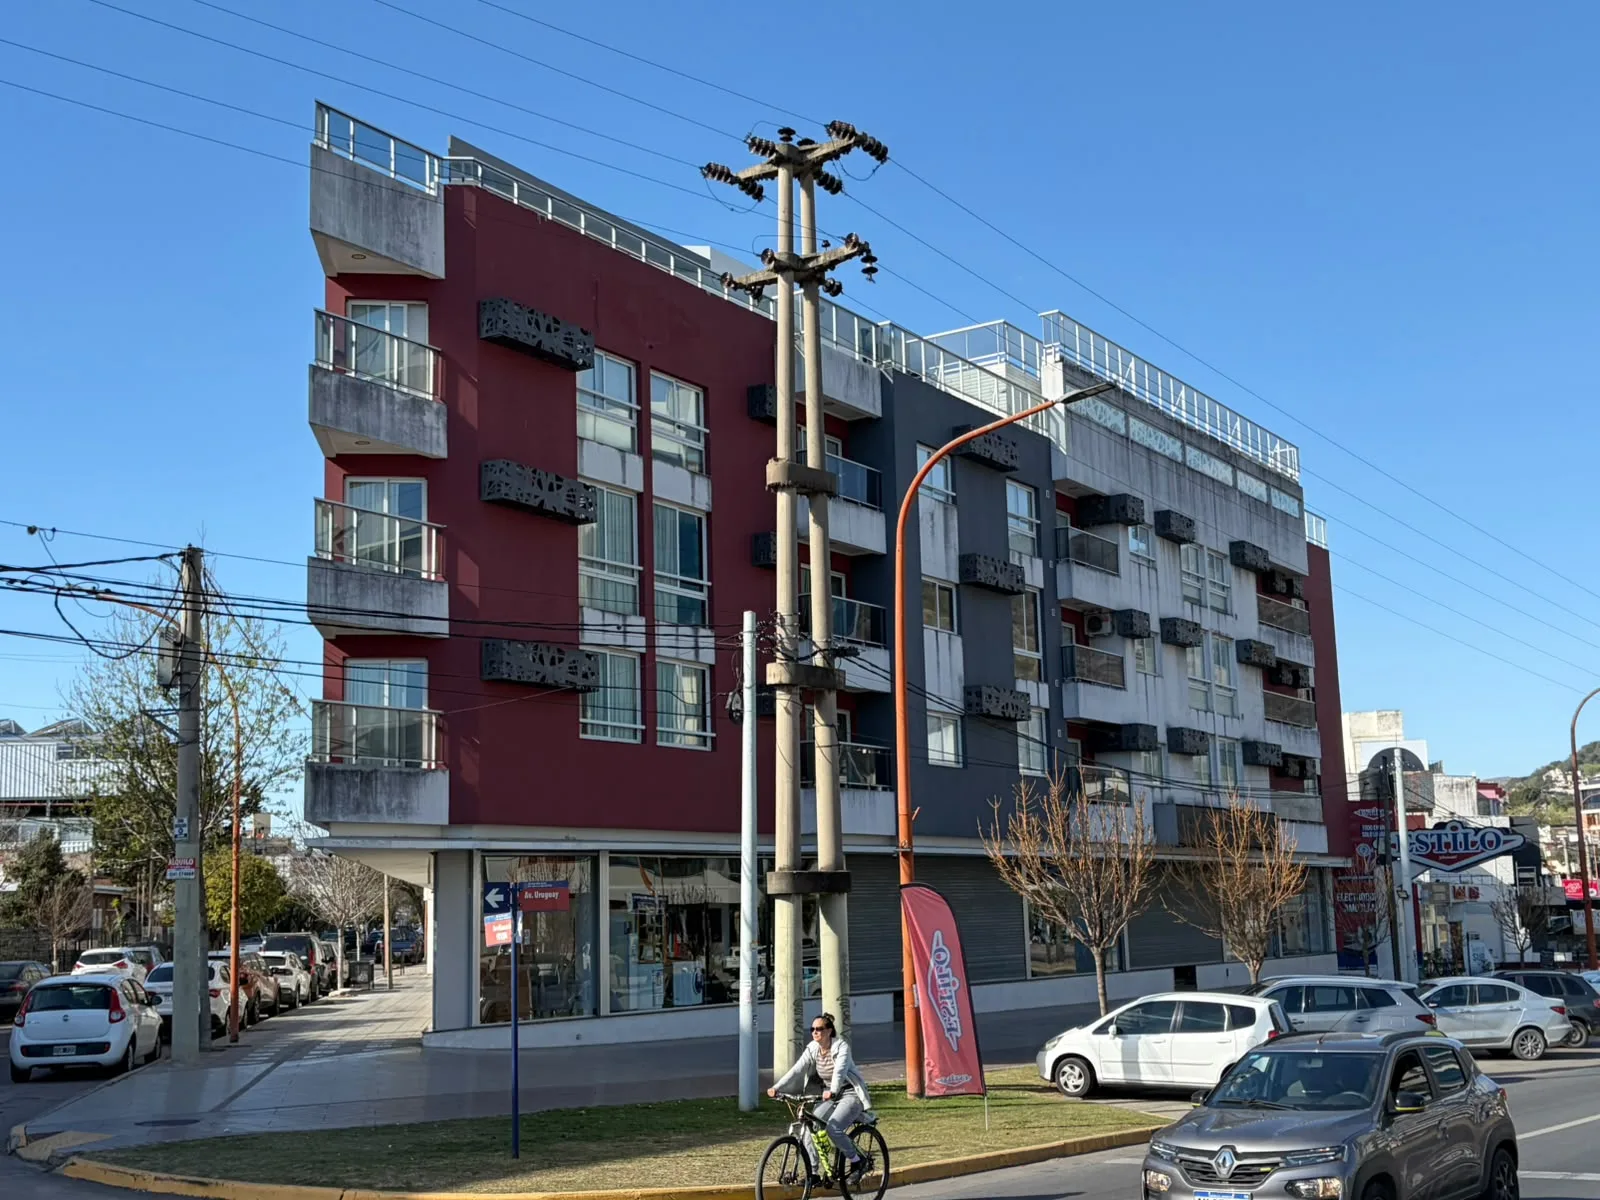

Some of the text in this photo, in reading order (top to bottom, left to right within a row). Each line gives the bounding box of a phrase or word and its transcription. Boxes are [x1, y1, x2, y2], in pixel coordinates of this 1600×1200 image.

[168, 857, 194, 866] ALQUILO
[524, 890, 559, 900] Av. Uruguay
